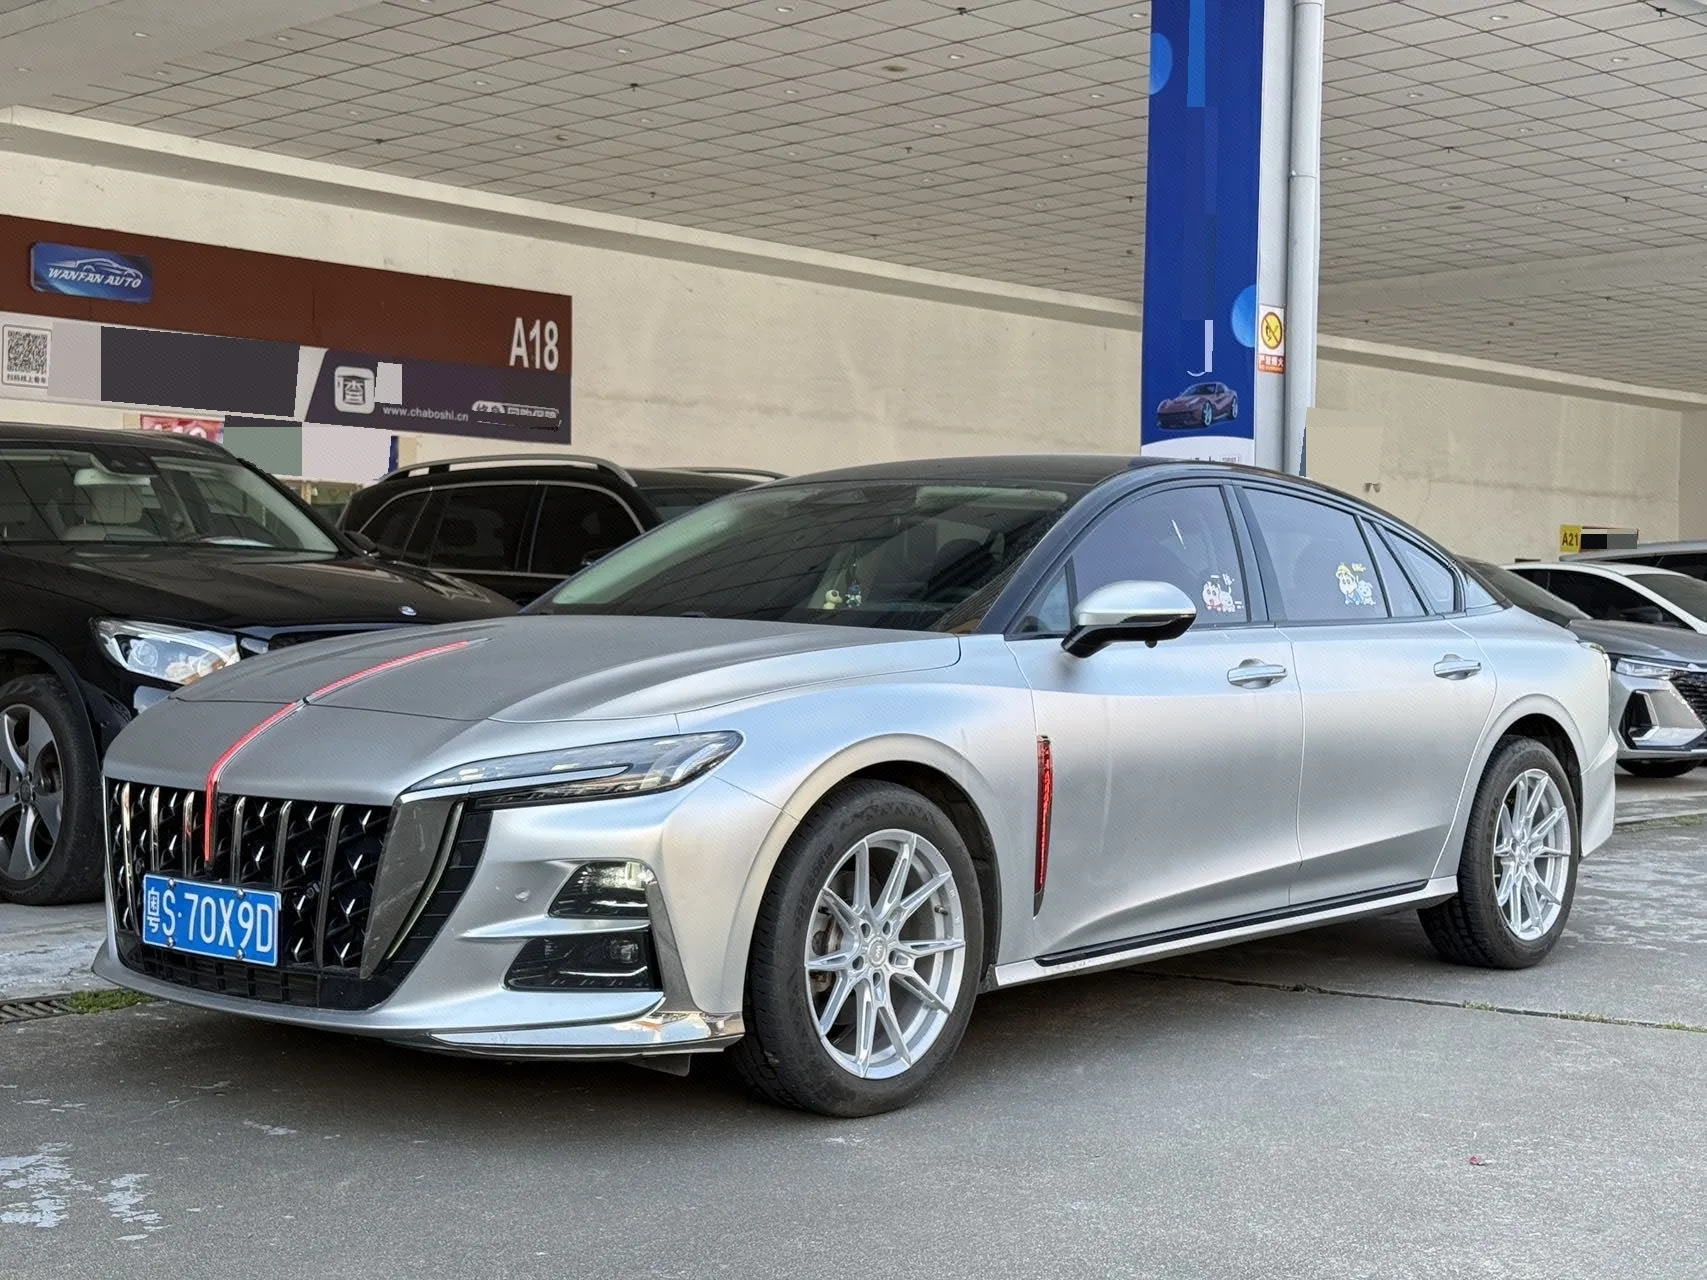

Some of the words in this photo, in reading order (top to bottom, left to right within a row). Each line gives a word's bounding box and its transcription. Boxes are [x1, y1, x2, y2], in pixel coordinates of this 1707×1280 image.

[48, 267, 104, 283] WANFAN
[105, 275, 142, 288] AUTO
[509, 317, 559, 371] A18
[383, 405, 469, 422] www.chaboshi.cn
[1562, 532, 1579, 546] A21
